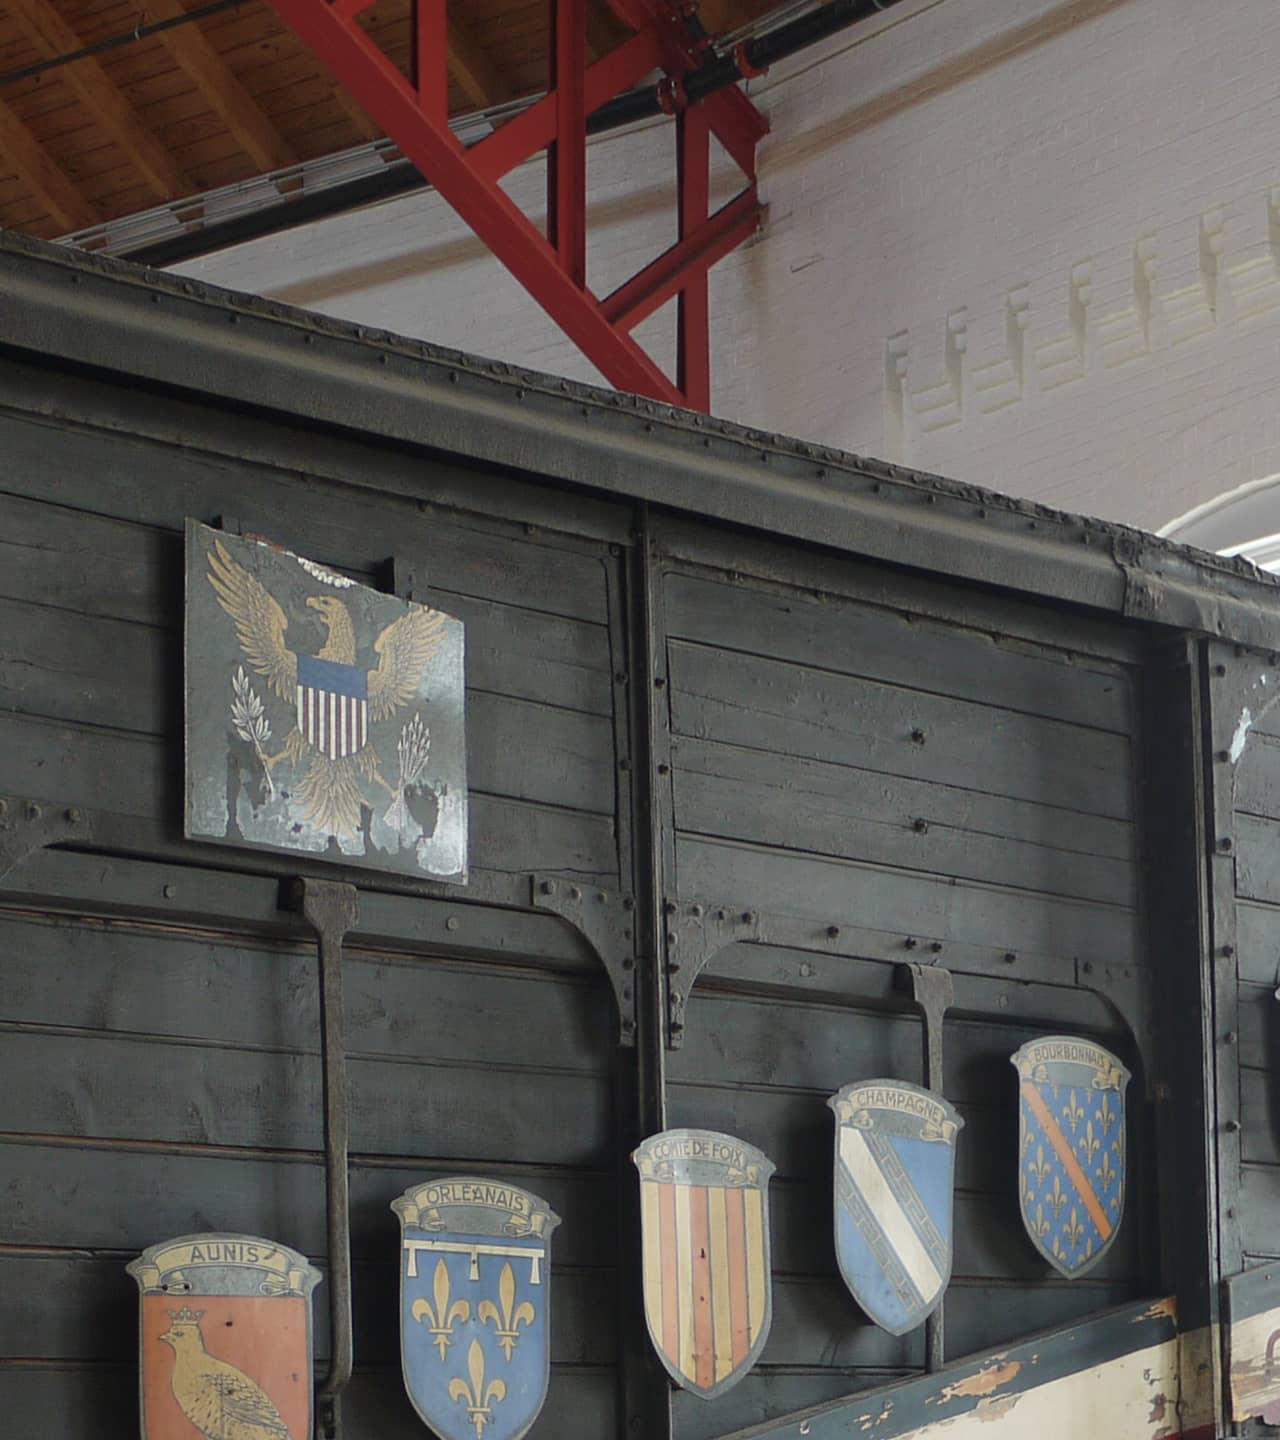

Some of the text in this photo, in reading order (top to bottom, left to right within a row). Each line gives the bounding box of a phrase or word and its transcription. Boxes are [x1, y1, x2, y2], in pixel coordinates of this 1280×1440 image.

[1033, 1044, 1106, 1069] BOURBONNAIS
[856, 1089, 945, 1123] CHAMPAGNE
[692, 1140, 710, 1157] DE
[711, 1143, 743, 1167] FOIX
[190, 1244, 260, 1263] AUNIS
